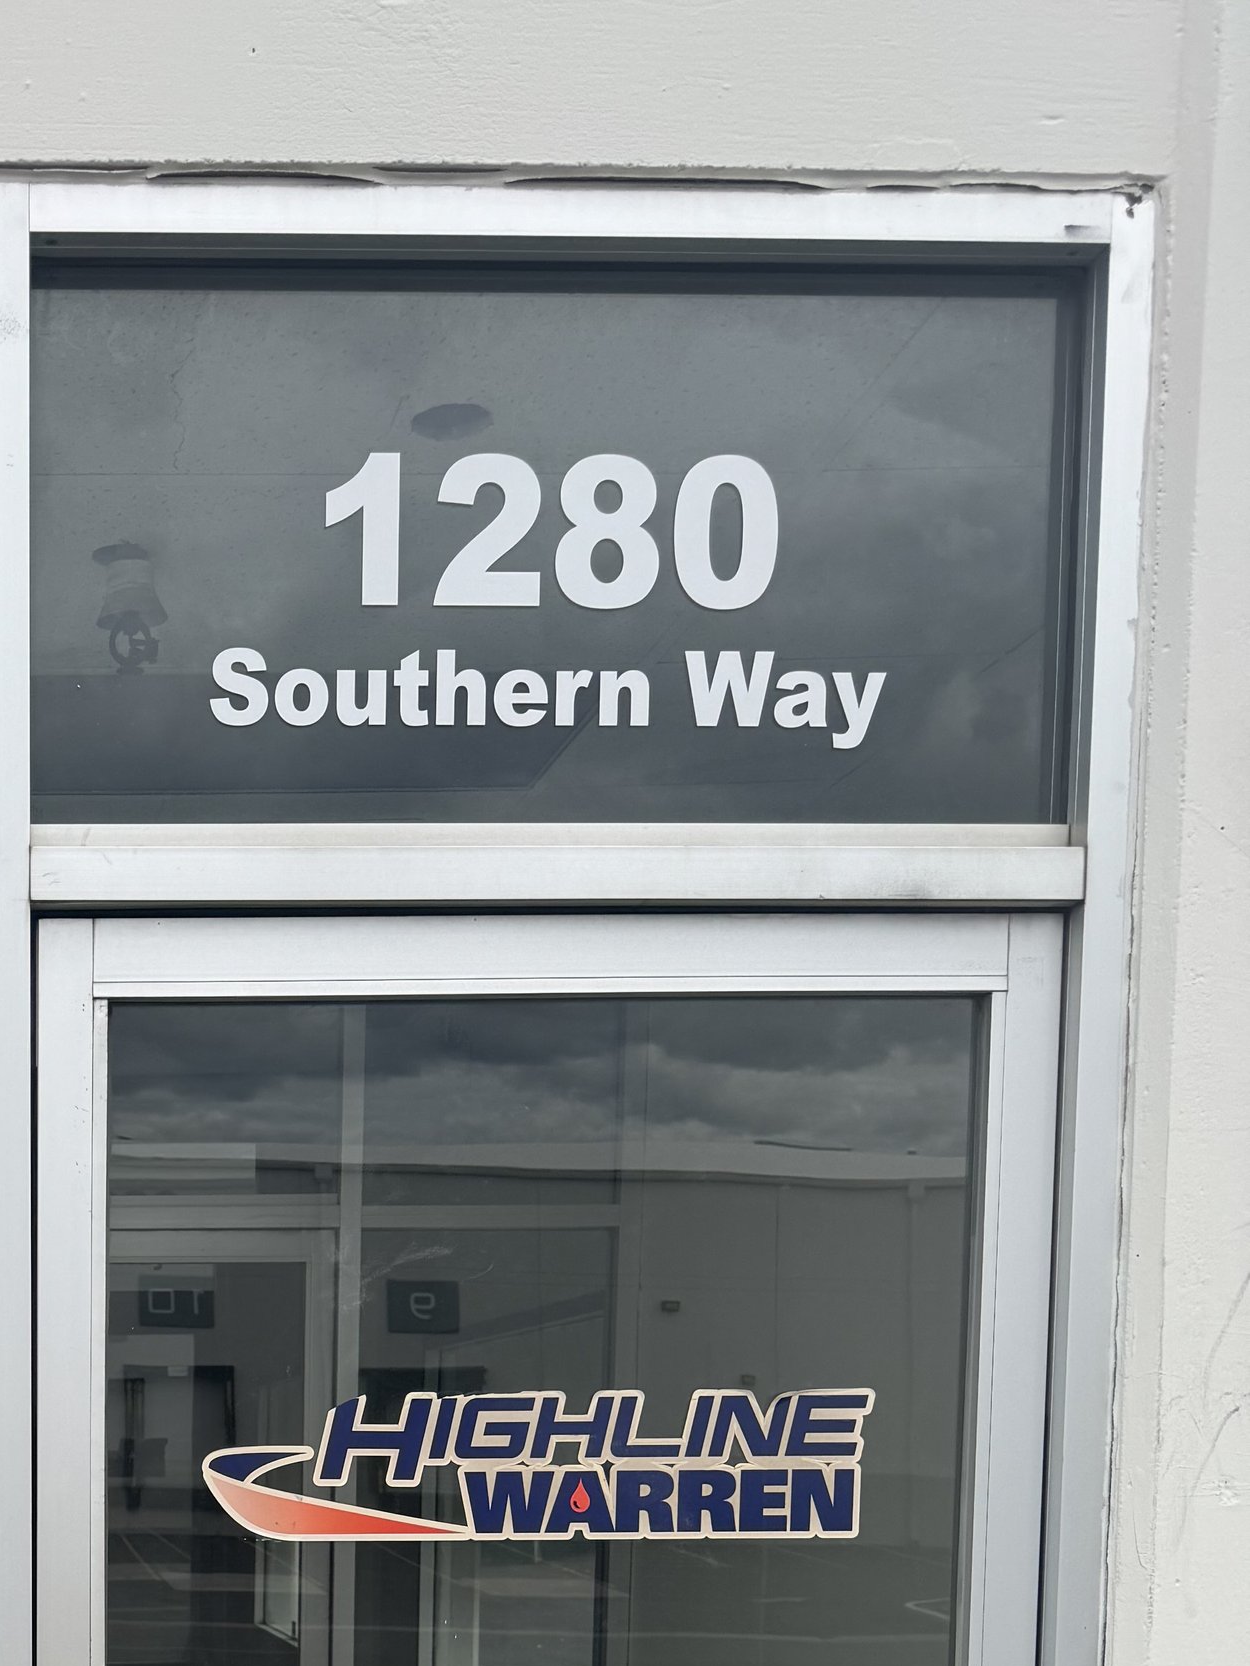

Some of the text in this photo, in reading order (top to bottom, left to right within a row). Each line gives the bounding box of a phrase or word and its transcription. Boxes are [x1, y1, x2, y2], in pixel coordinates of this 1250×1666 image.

[325, 452, 779, 610] 1280
[209, 647, 887, 750] Southern Way
[313, 1389, 876, 1486] HIGHLINE
[464, 1467, 858, 1536] WARREN
